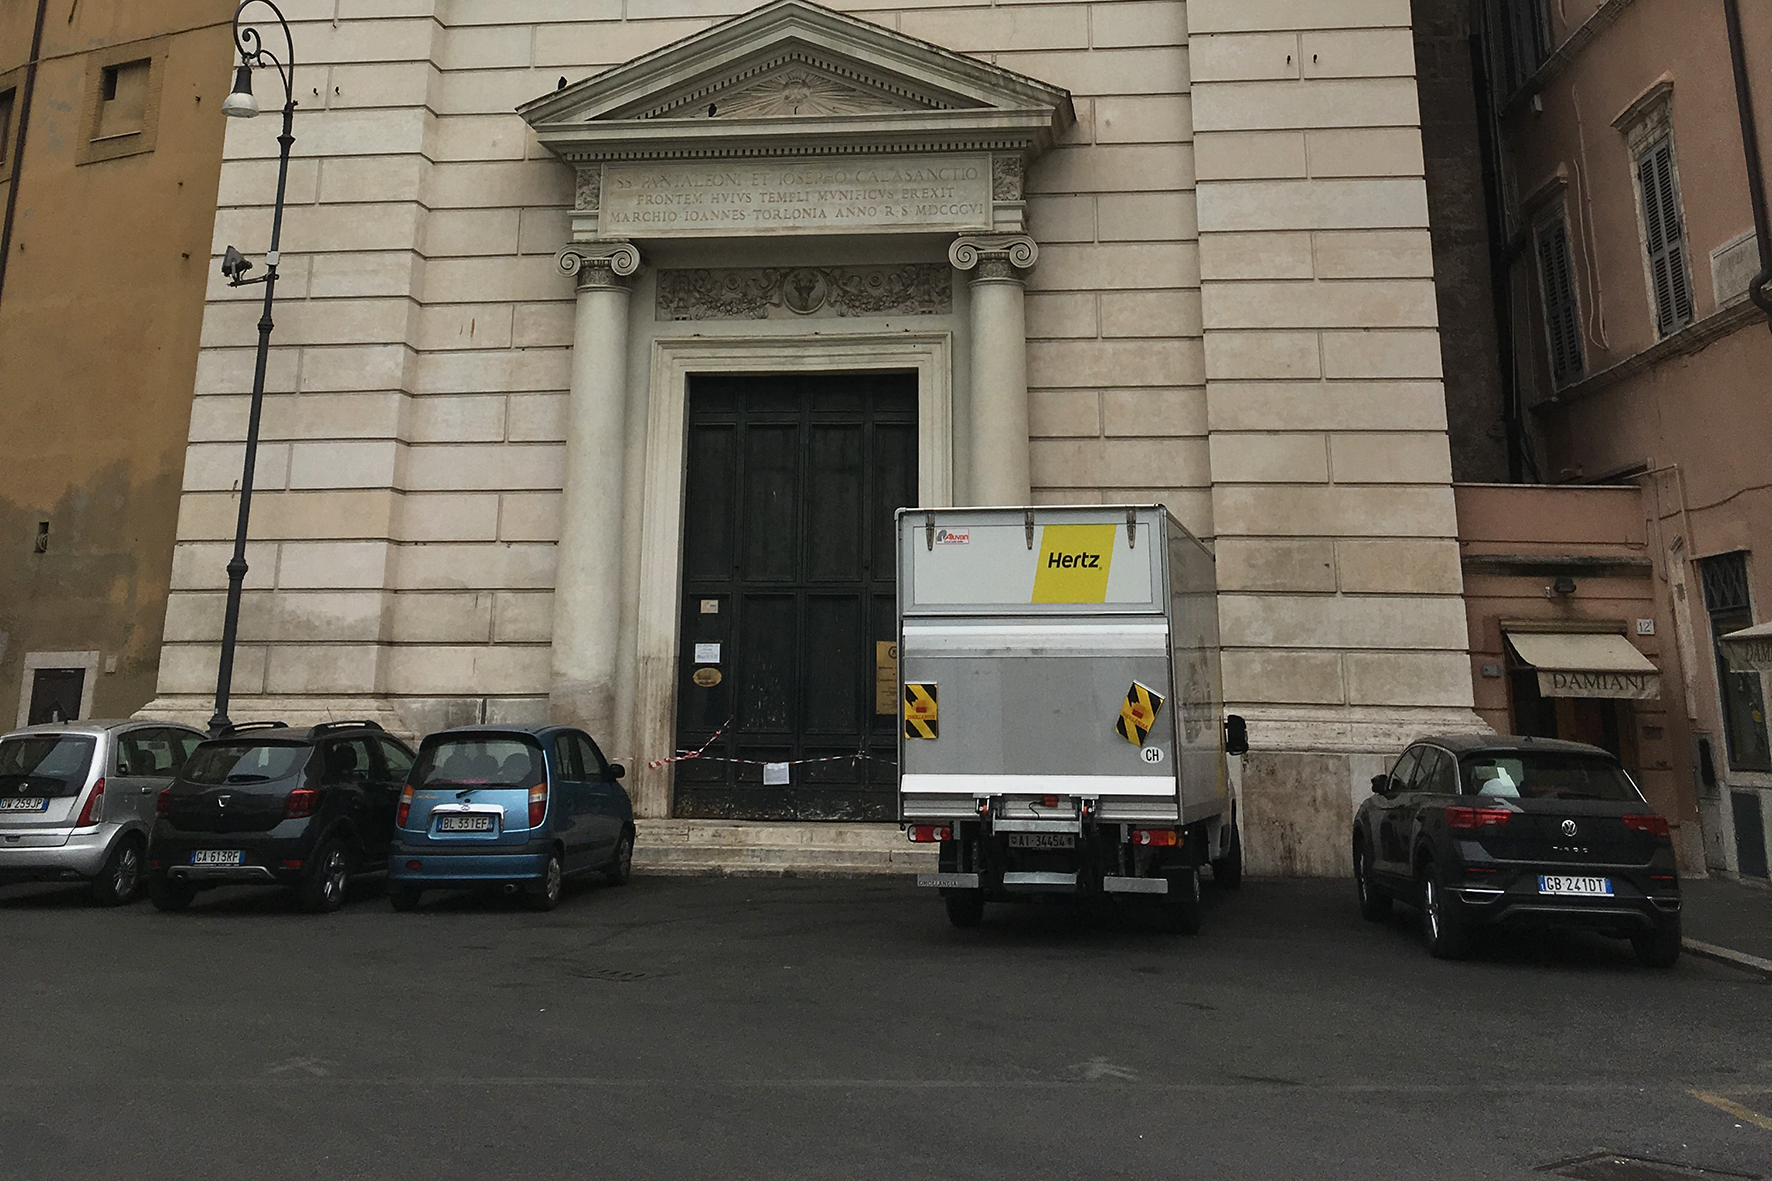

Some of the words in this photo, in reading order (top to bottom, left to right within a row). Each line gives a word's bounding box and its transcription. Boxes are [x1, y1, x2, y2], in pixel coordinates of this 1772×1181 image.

[751, 173, 770, 186] ET
[636, 193, 703, 206] FRONTEM
[710, 192, 752, 205] HVIVS
[759, 190, 810, 204] TEMPLI
[817, 188, 894, 203] MVNIFICVS
[610, 211, 678, 224] MARCHIO
[684, 209, 746, 222] IOANNES
[752, 207, 827, 221] TORLONIA
[835, 205, 877, 218] ANNO
[1048, 552, 1100, 568] Hertz
[1552, 673, 1647, 691] DAMIANI
[1146, 749, 1159, 761] CH
[443, 818, 454, 829] BL
[210, 851, 239, 862] 613RF
[1546, 877, 1562, 891] GB
[1566, 878, 1603, 892] 241DT
